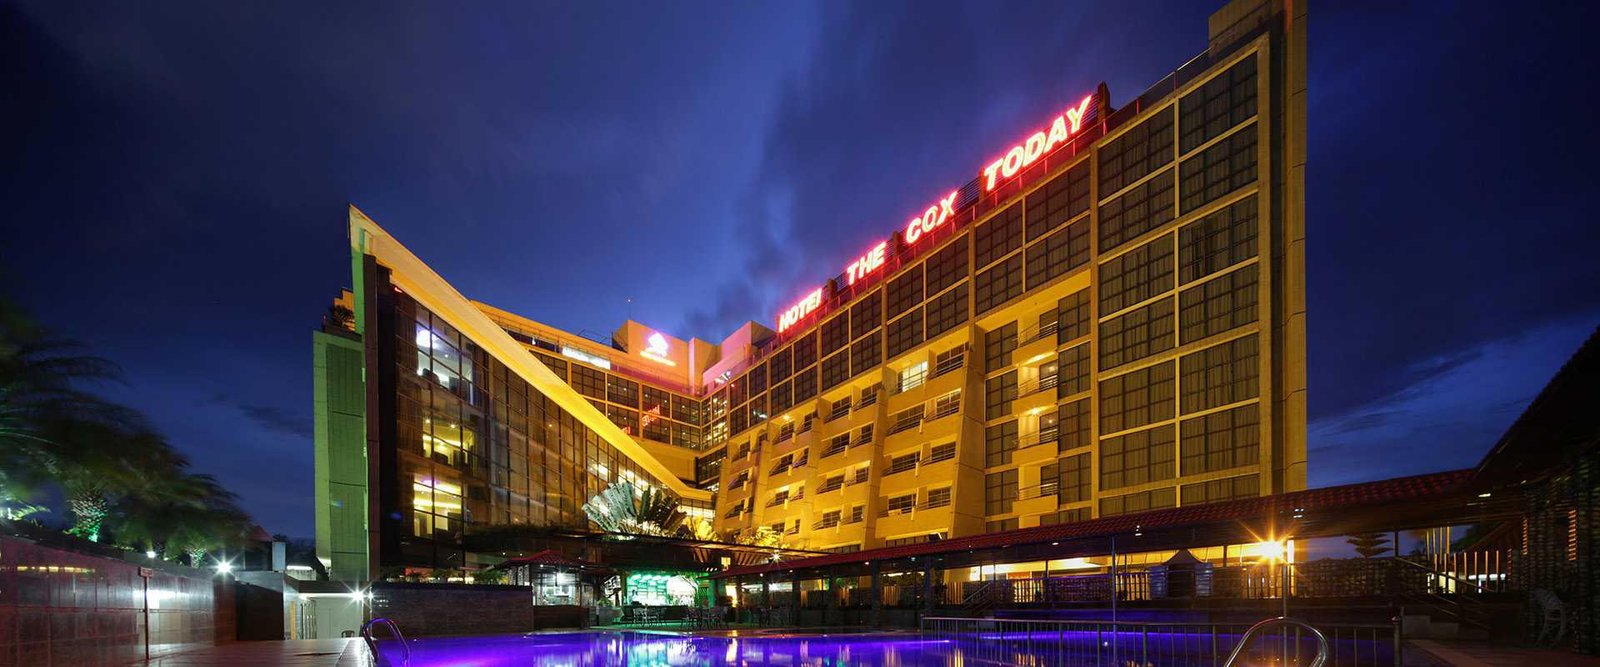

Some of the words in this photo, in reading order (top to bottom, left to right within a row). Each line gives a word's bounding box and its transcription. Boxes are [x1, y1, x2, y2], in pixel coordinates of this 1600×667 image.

[846, 242, 888, 285] THE
[905, 190, 958, 244] COX
[983, 95, 1093, 191] TODAY
